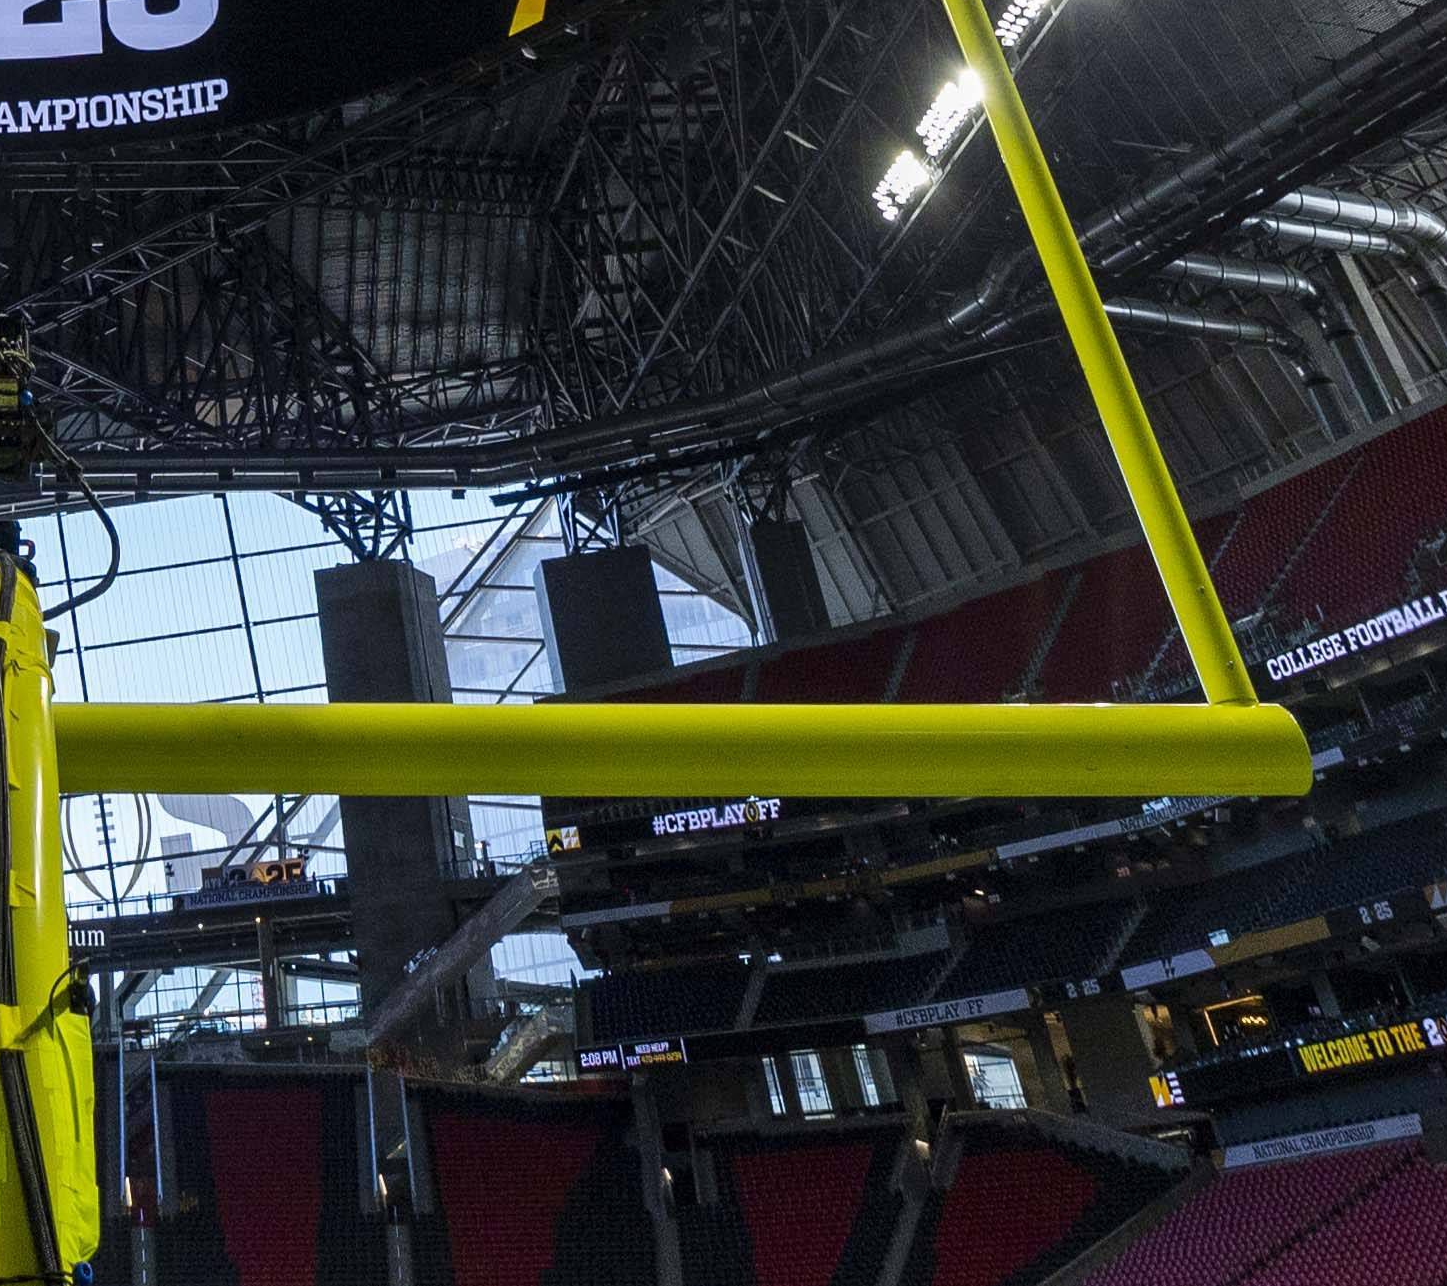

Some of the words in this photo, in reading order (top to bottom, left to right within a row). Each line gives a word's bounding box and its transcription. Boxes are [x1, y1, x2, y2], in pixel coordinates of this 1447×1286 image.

[1266, 633, 1348, 680] COLLEGE
[1345, 595, 1444, 646] FOOTBALL
[1358, 901, 1395, 926] 225
[1065, 977, 1101, 1000] 225
[896, 998, 984, 1027] #CFBPLAYFF
[580, 1050, 602, 1067] 2:08
[603, 1049, 619, 1065] PM
[1298, 1035, 1374, 1074] WELCOME
[1368, 1028, 1395, 1059] TO
[1388, 1021, 1427, 1054] THE
[1252, 1138, 1301, 1159] NATIONAL
[1300, 1126, 1375, 1151] CHAMPIONSHIP
